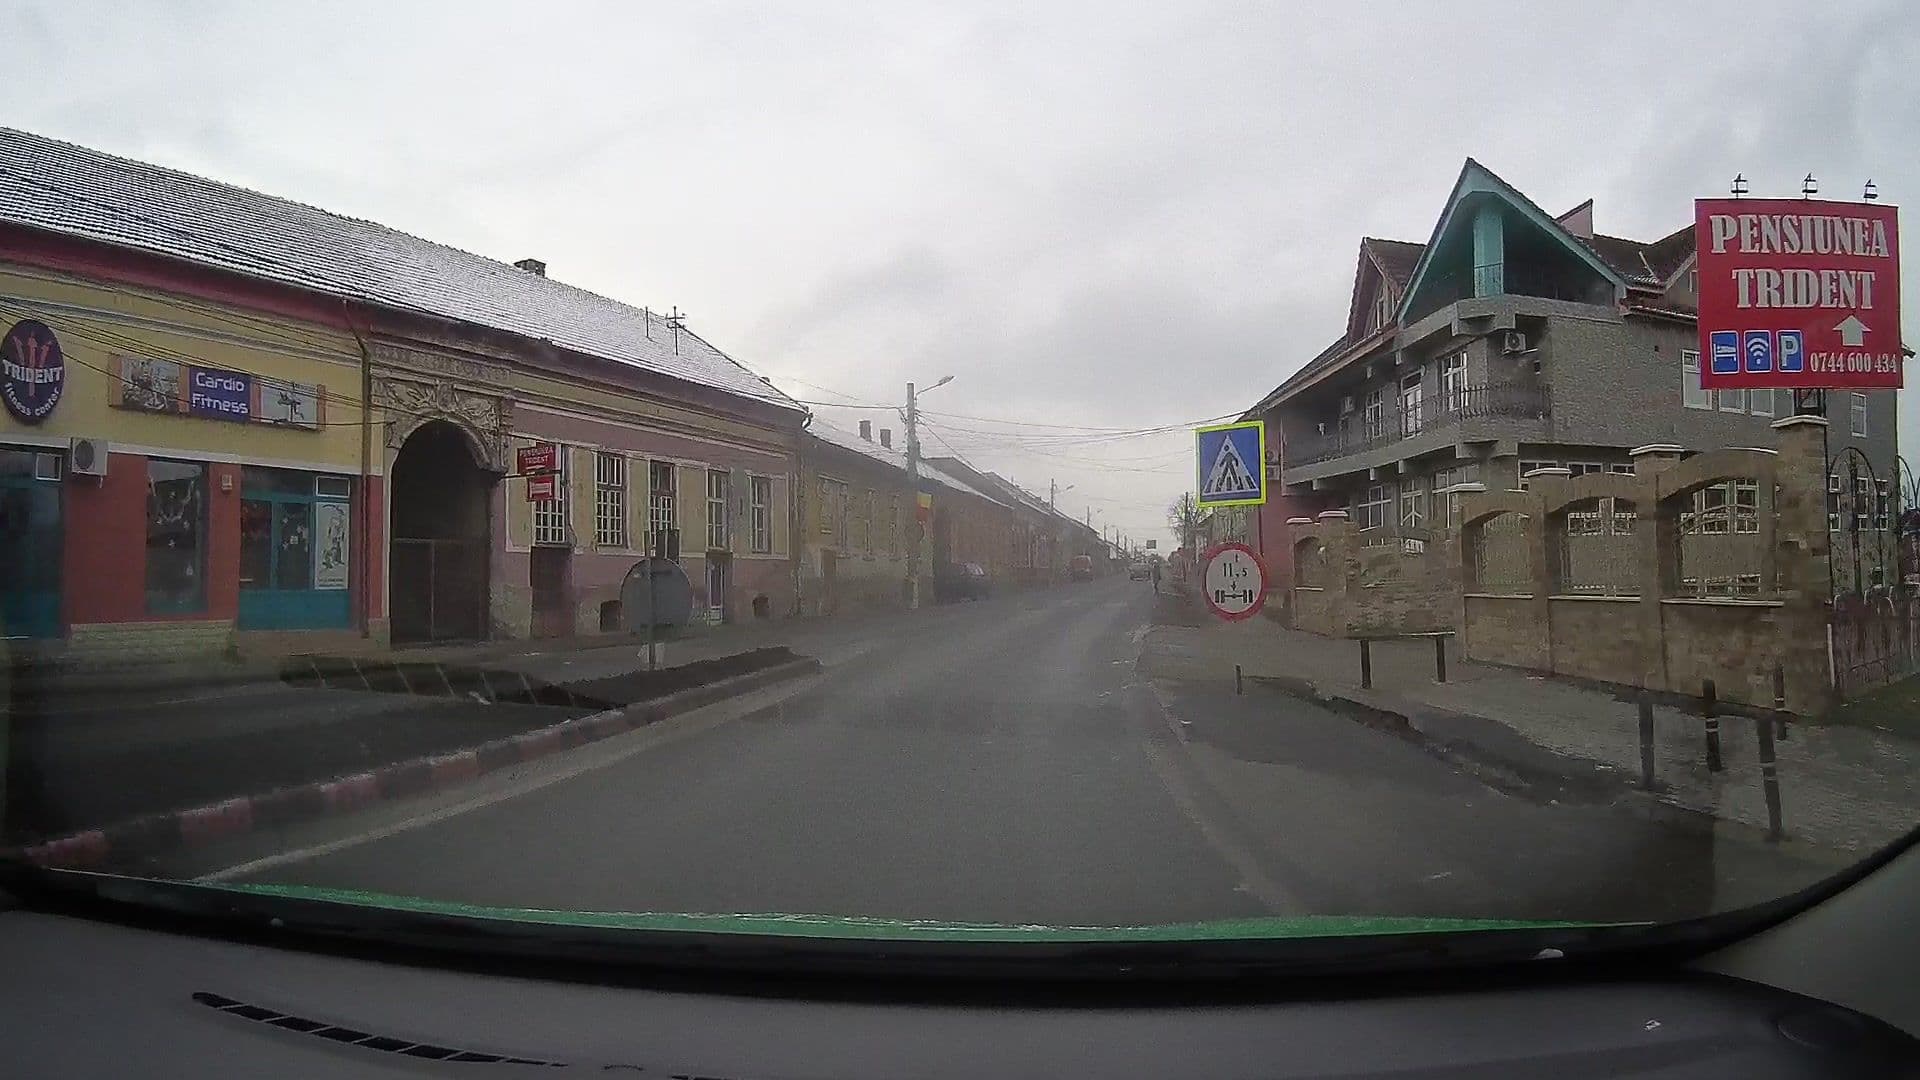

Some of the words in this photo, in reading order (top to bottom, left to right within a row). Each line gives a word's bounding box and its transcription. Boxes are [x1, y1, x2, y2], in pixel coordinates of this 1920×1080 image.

[1709, 214, 1889, 257] PENSIUNEA
[1732, 268, 1876, 309] TRIDENT
[1780, 335, 1799, 367] P
[1810, 353, 1844, 372] 0744
[1847, 353, 1872, 372] 600
[1874, 354, 1897, 373] 434
[2, 359, 63, 384] TRIDENT
[195, 372, 245, 392] Cardio
[192, 393, 249, 415] Fitness
